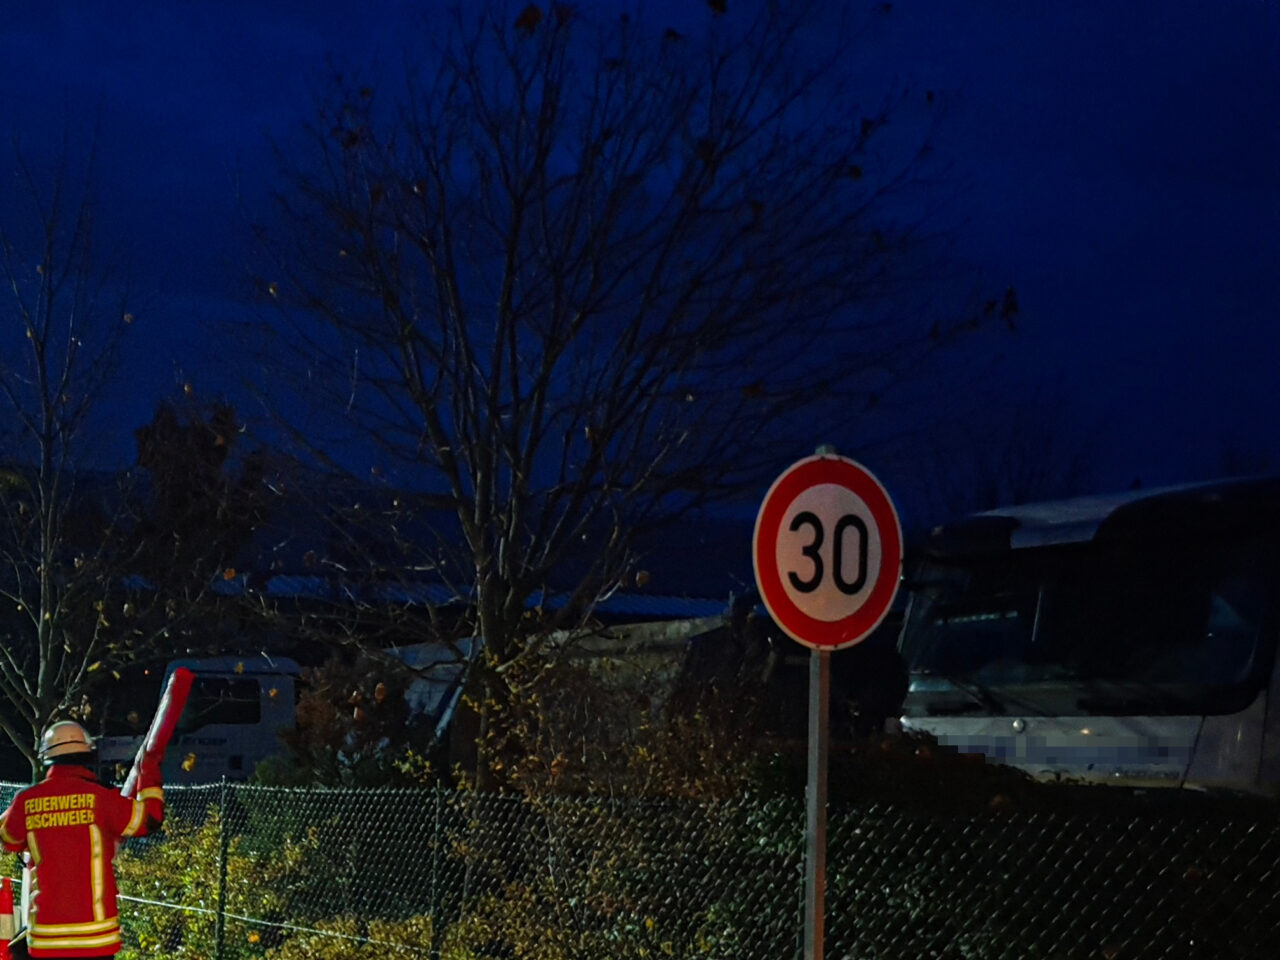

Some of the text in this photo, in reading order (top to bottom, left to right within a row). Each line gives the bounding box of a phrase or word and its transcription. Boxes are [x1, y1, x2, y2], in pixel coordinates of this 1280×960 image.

[788, 511, 868, 595] 30
[25, 793, 96, 814] FEUERWEHR
[25, 809, 95, 830] BISCHWEIER
